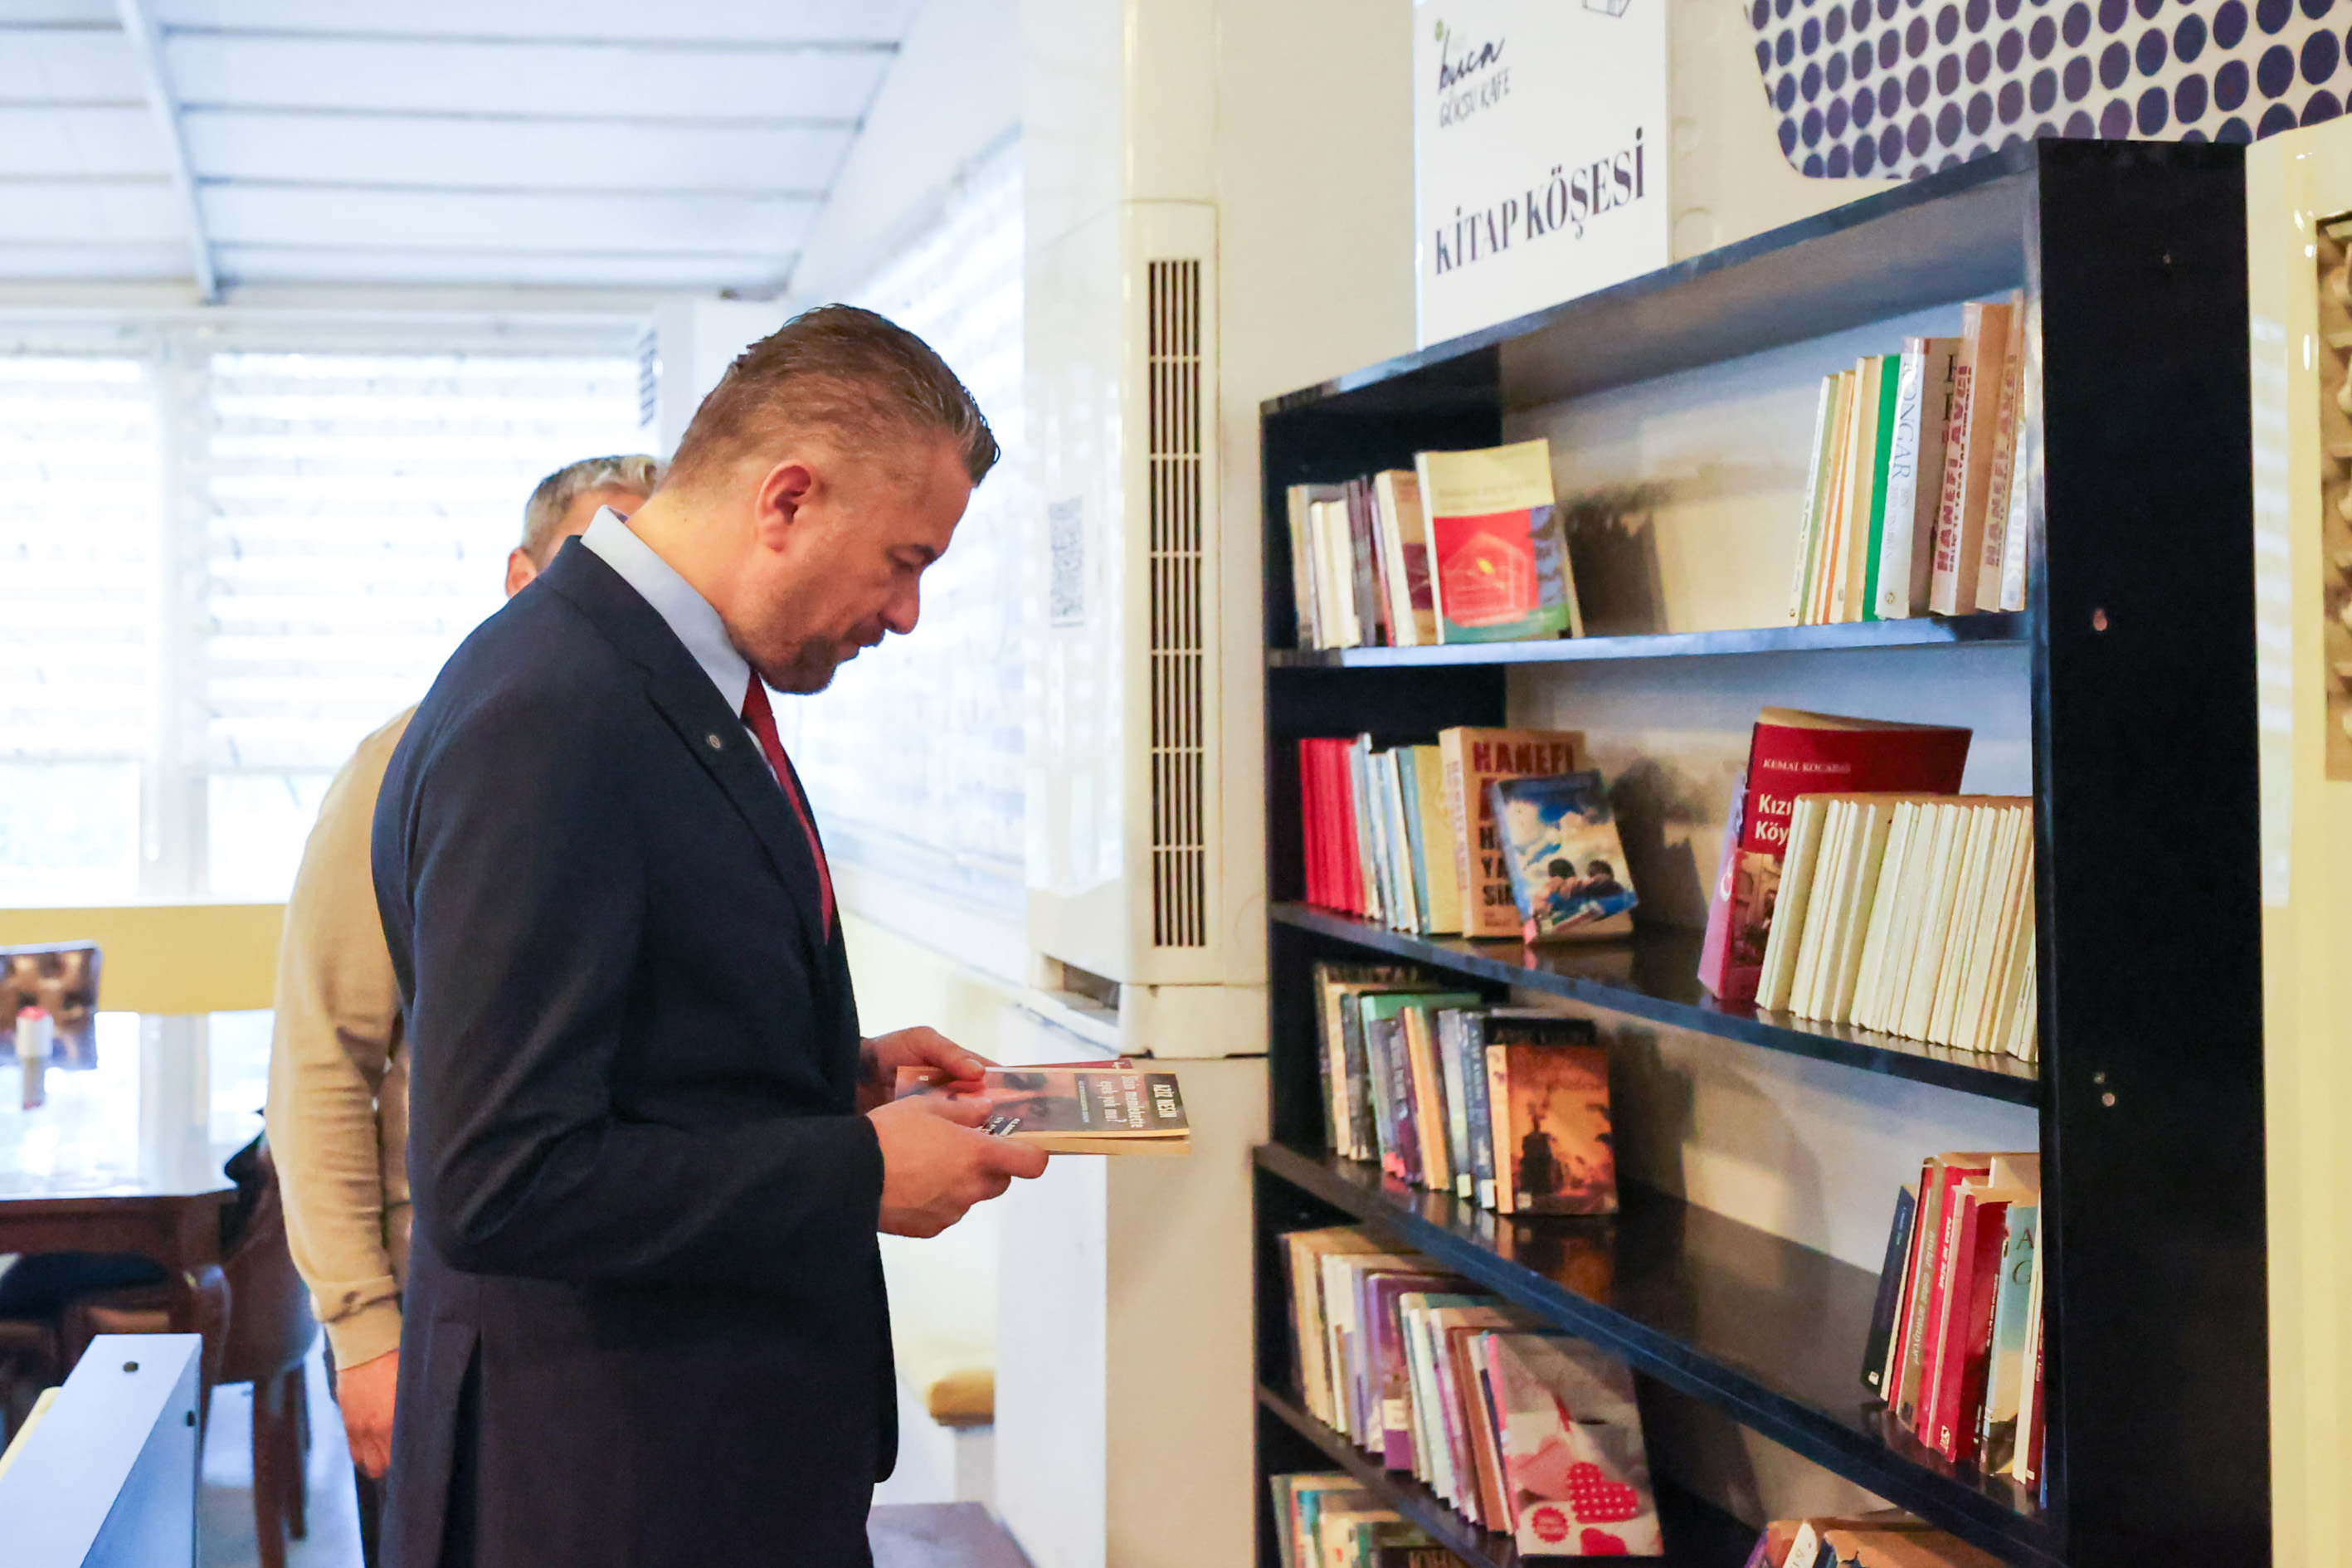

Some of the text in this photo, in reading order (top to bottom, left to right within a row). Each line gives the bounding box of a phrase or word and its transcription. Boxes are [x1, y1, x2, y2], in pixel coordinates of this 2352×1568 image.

[1436, 126, 1644, 275] KİTAP KÖŞESİ
[1763, 758, 1799, 772] KEMAL
[1096, 1081, 1119, 1095] eşek
[1097, 1096, 1122, 1108] yok
[1152, 1084, 1179, 1118] AZİZ NESİN
[1104, 1108, 1127, 1123] mu?
[1125, 1091, 1146, 1128] memlekette
